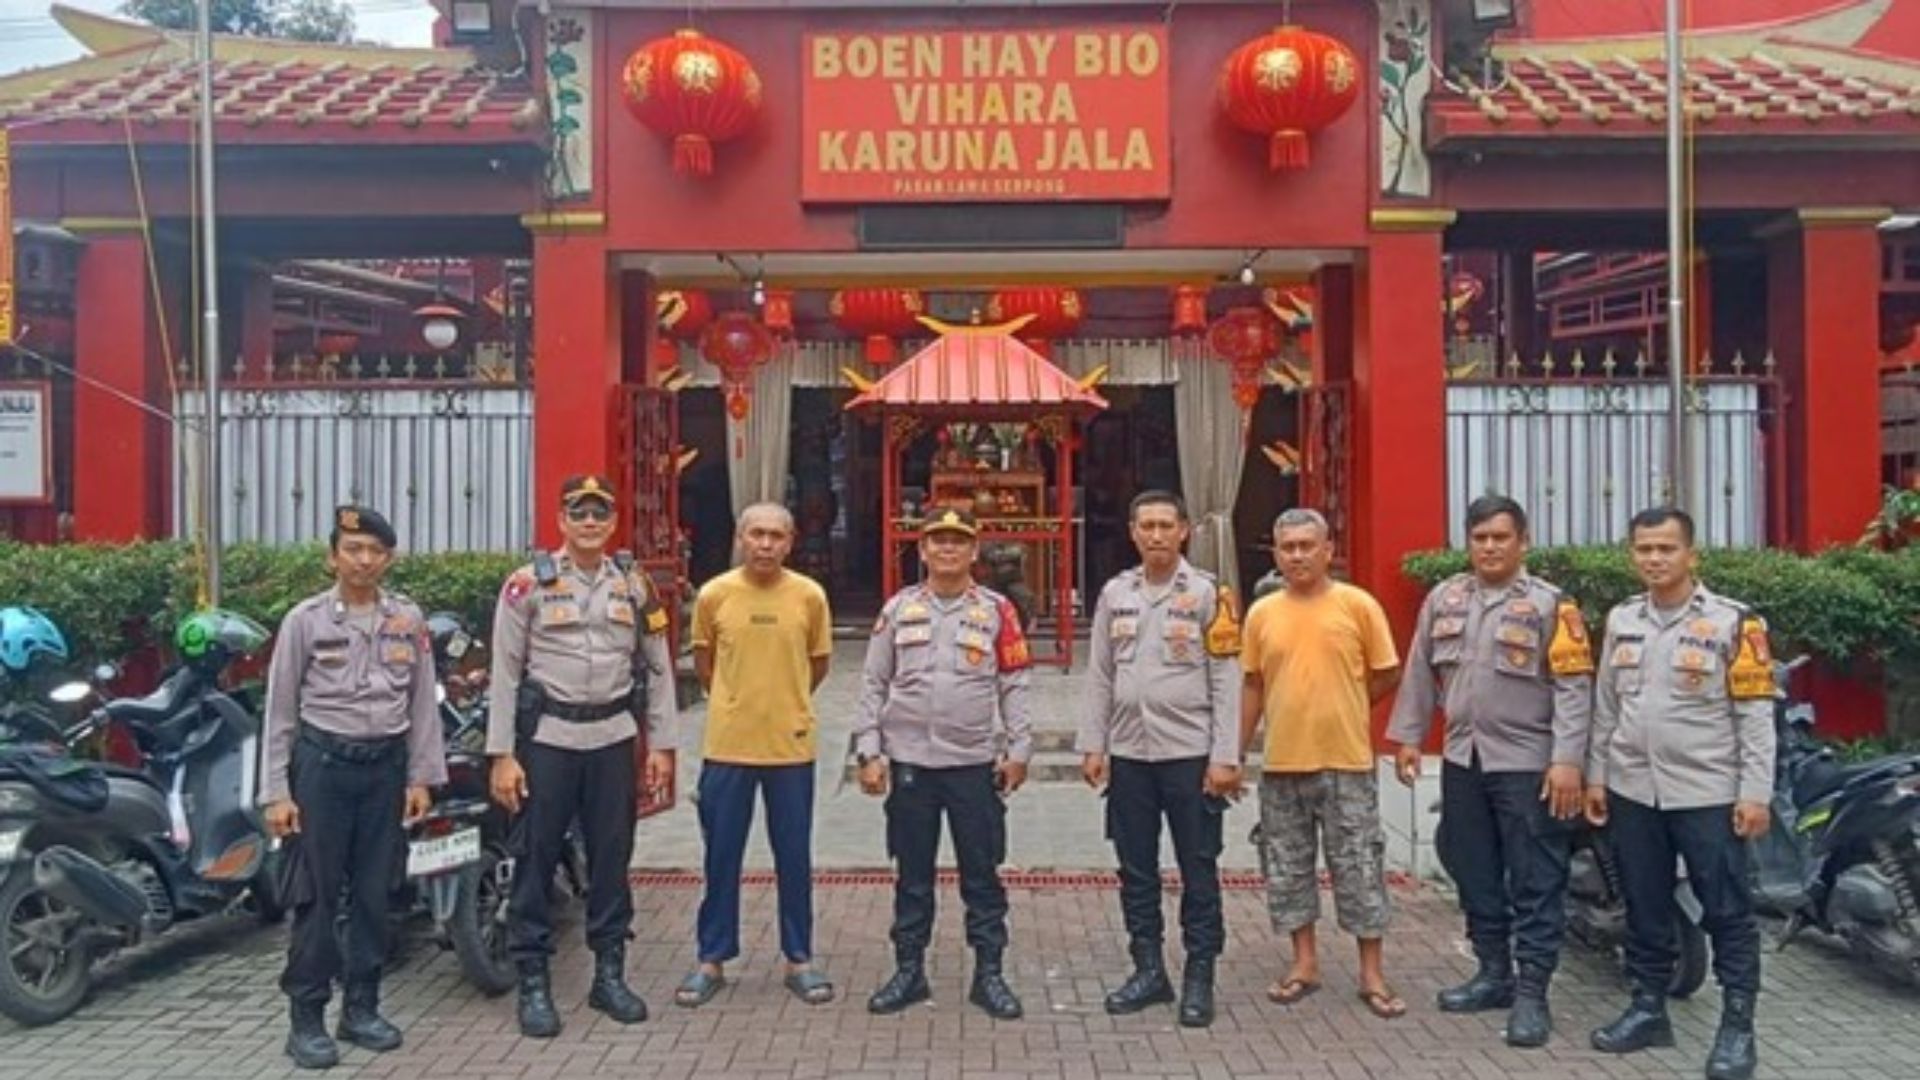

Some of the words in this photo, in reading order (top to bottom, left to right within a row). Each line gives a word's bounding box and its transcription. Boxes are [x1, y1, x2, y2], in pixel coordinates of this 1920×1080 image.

[812, 35, 943, 79] BOEN
[962, 34, 1056, 77] HAY
[1074, 33, 1160, 76] BIO
[892, 82, 1079, 125] VIHARA
[818, 130, 1019, 172] KARUNA
[1036, 129, 1154, 171] JALA
